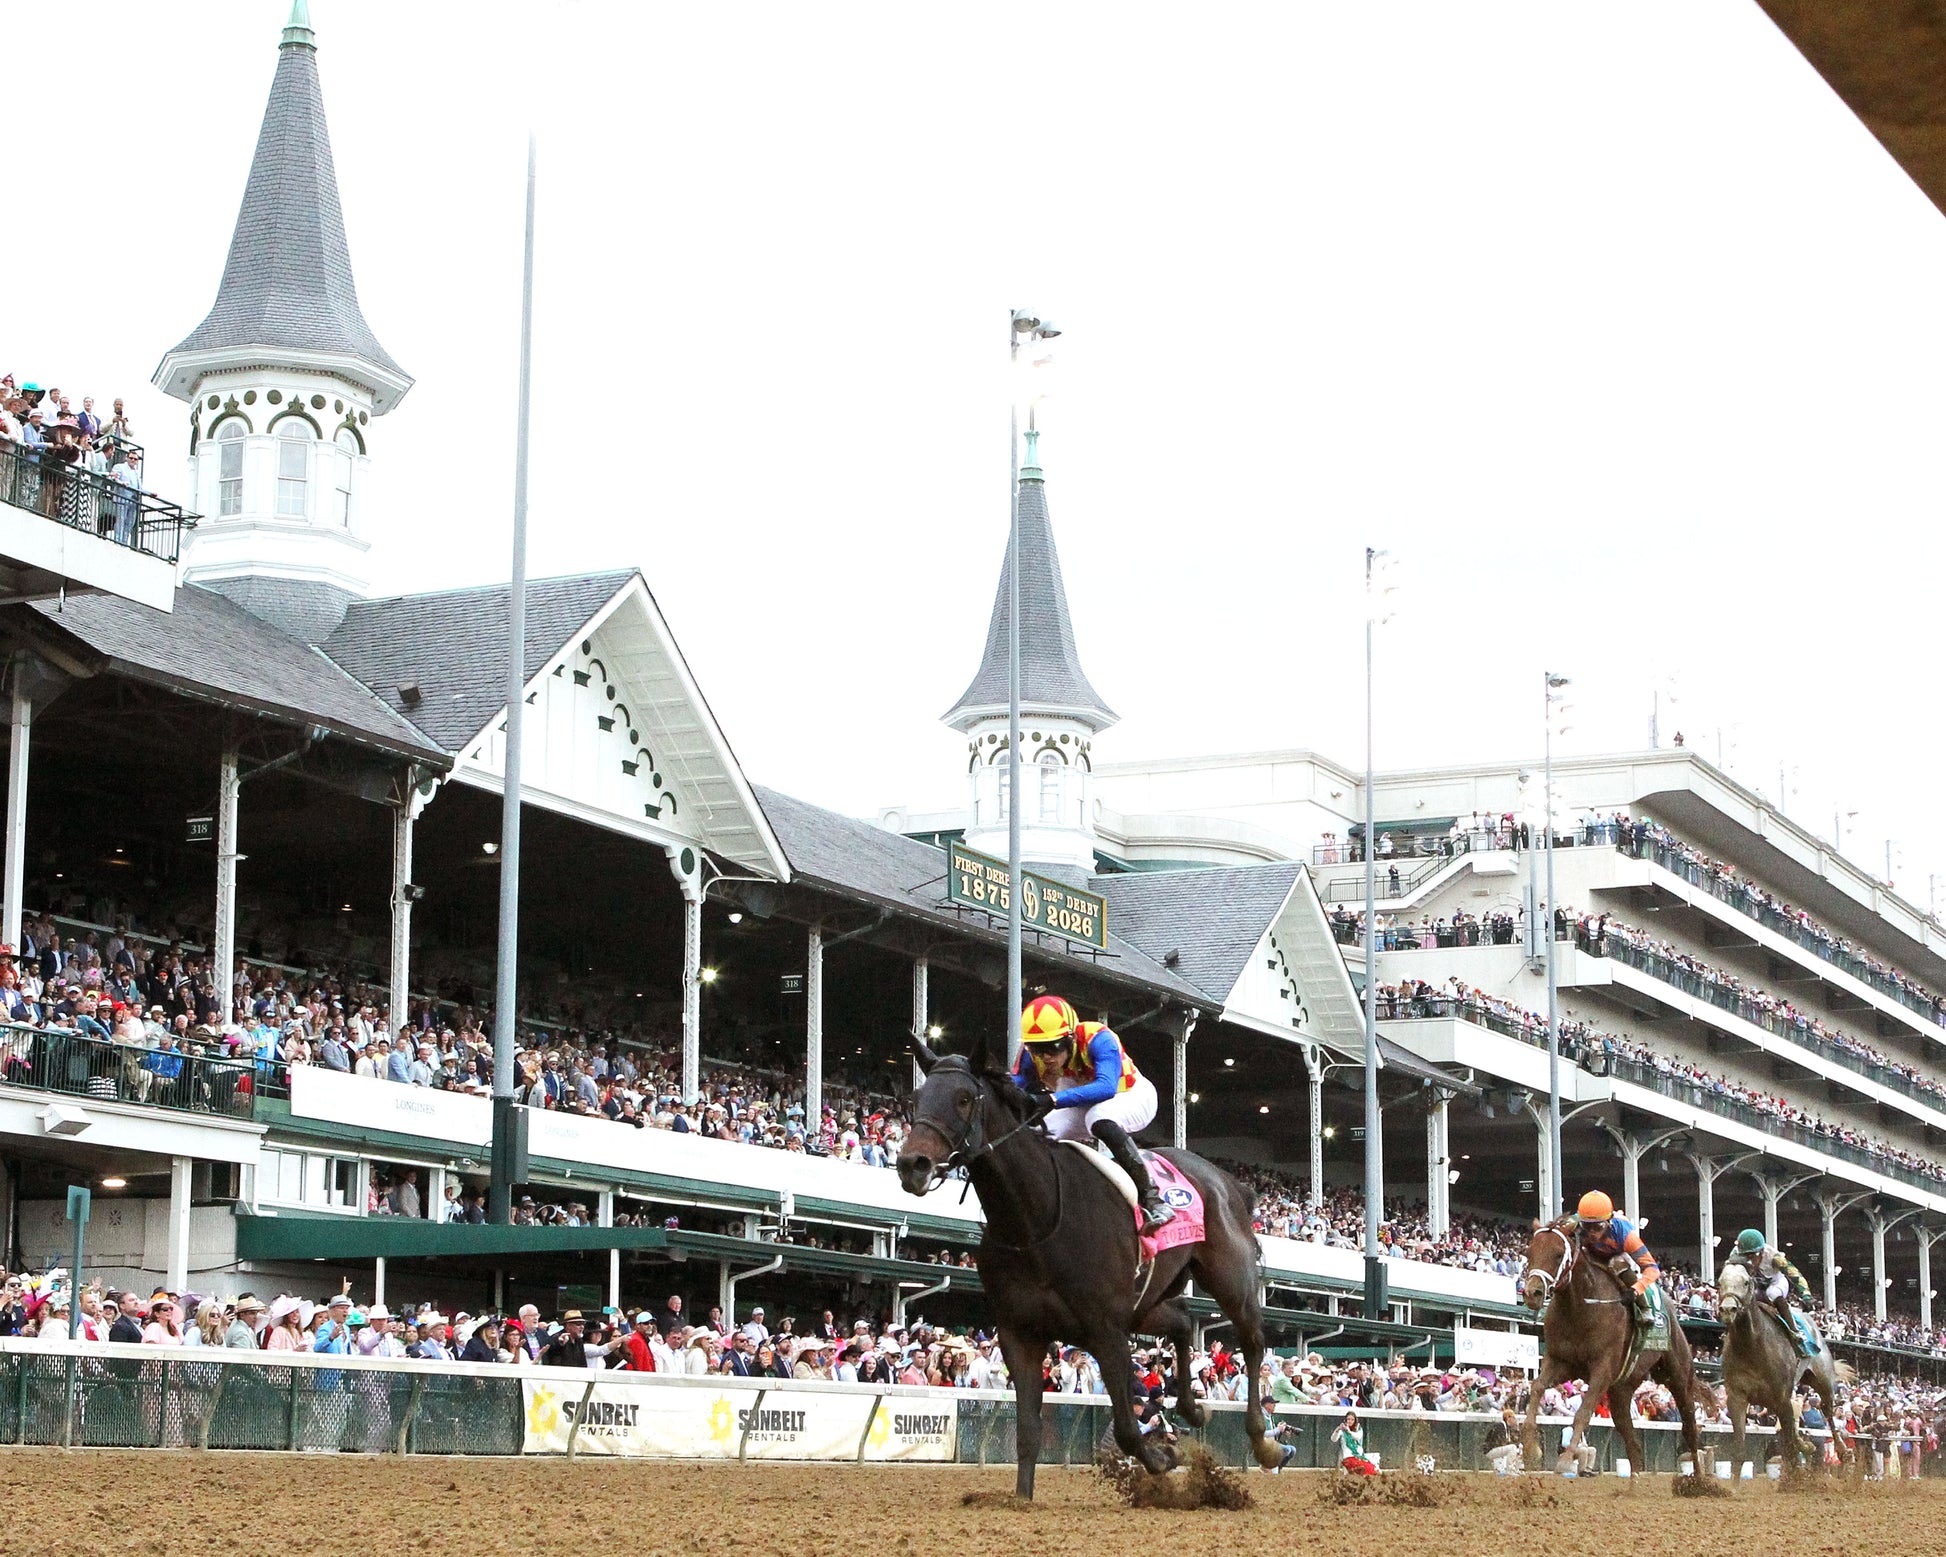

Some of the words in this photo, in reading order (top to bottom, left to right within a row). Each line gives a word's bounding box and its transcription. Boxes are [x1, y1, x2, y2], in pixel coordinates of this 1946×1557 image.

[190, 824, 208, 835] 318
[954, 855, 983, 877] FIRST
[985, 866, 1010, 887] DERB
[961, 875, 1010, 910] 1875
[1066, 895, 1099, 918] DERBY
[1047, 904, 1093, 938] 2026
[784, 980, 799, 988] 318
[395, 1099, 436, 1116] LONGINES
[1178, 1225, 1204, 1241] ELVIS
[738, 1409, 806, 1433] SUNBELT
[894, 1414, 950, 1436] SUNBELT
[578, 1426, 629, 1438] ENTALS
[901, 1436, 941, 1445] RENTALS
